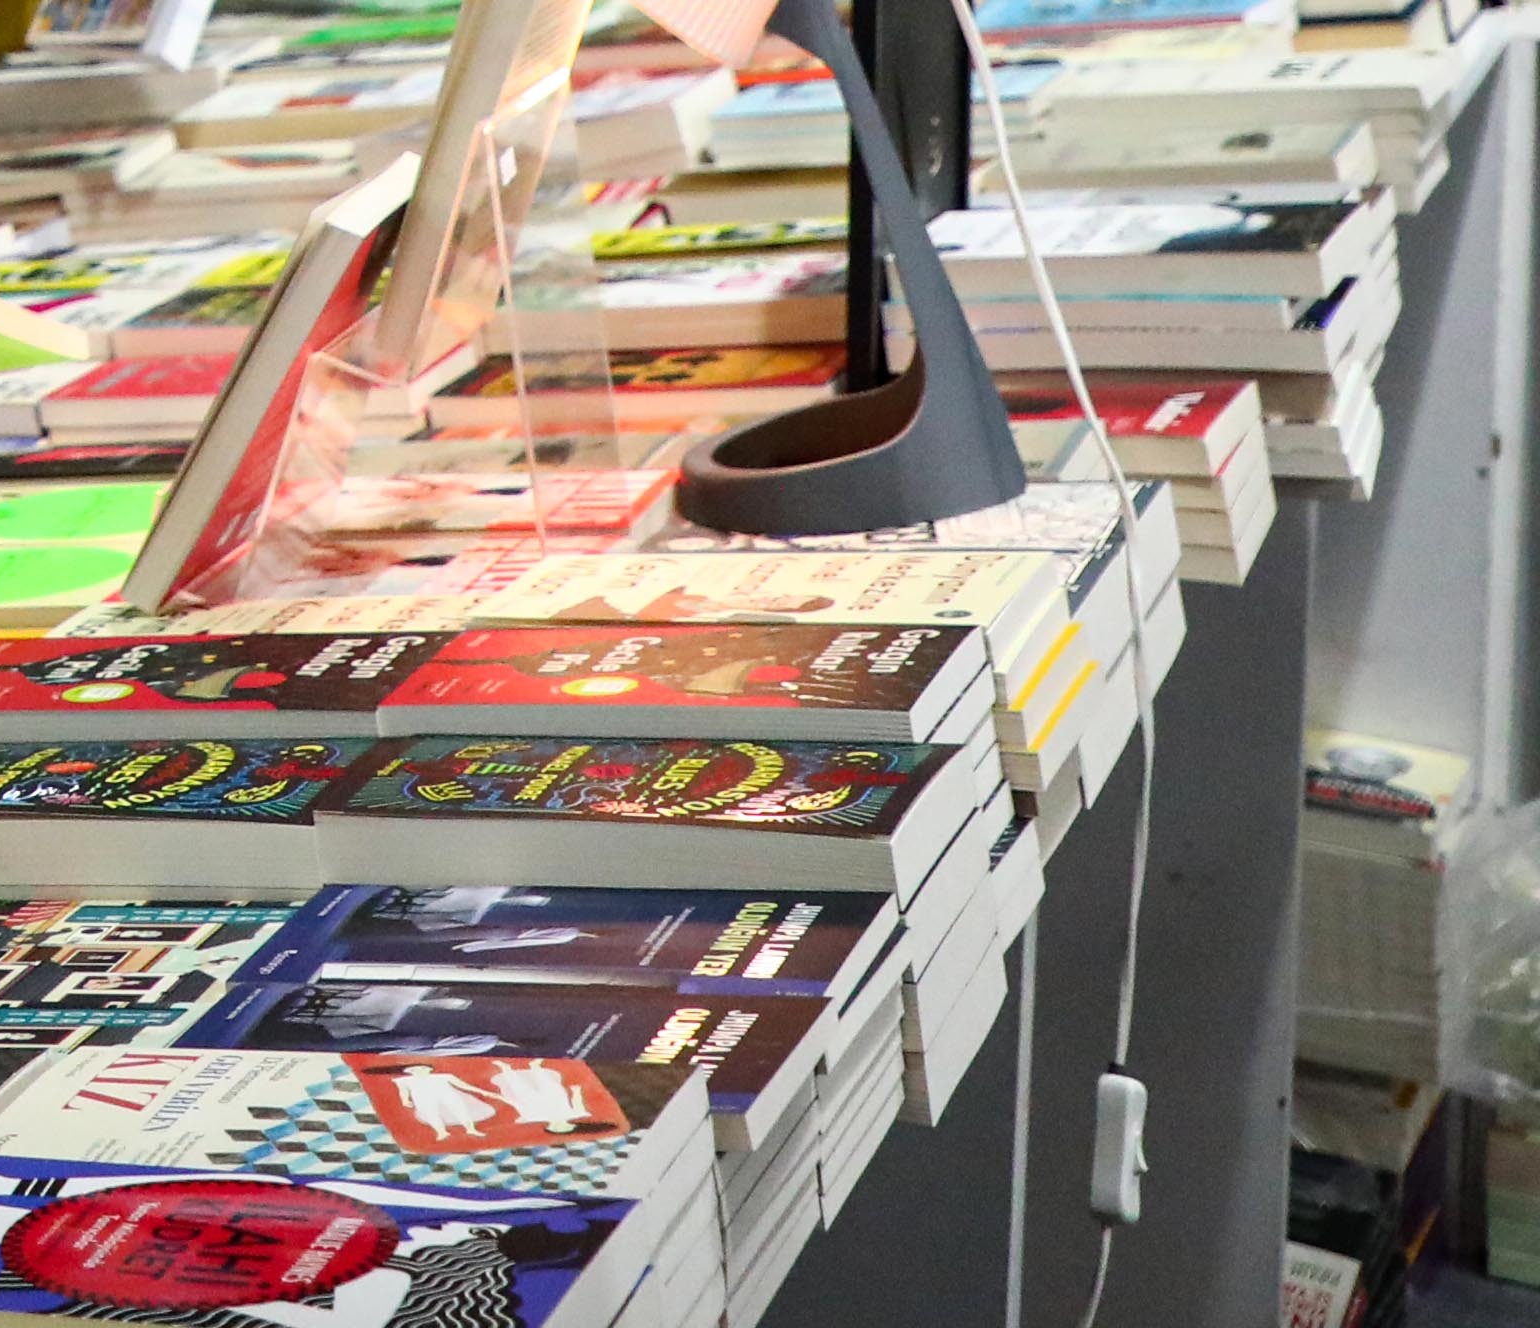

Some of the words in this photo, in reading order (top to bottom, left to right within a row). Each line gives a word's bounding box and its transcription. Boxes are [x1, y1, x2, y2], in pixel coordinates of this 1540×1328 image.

[97, 644, 168, 679] Cecile
[296, 639, 371, 677] Ruhlar
[349, 636, 426, 679] Gezgin
[539, 653, 590, 673] Pin
[593, 636, 662, 673] Cecile
[811, 631, 880, 671] Ruhlar
[867, 628, 940, 674] Gezgin
[47, 660, 98, 681] Pin
[103, 741, 236, 810] REENKARNASYON
[105, 754, 169, 785] BLUES
[652, 758, 710, 791] BLUES
[656, 743, 785, 819] REENKARNASYON
[710, 903, 778, 951] OLDUĞUM
[770, 903, 823, 941] JHUMPA
[691, 954, 739, 976] YER
[635, 1008, 711, 1063] OLDUĞUM
[698, 1010, 759, 1053] JHUMPA
[62, 1053, 204, 1112] KIZ
[313, 1217, 366, 1252] NATALIE
[281, 1248, 334, 1285] HAYNES
